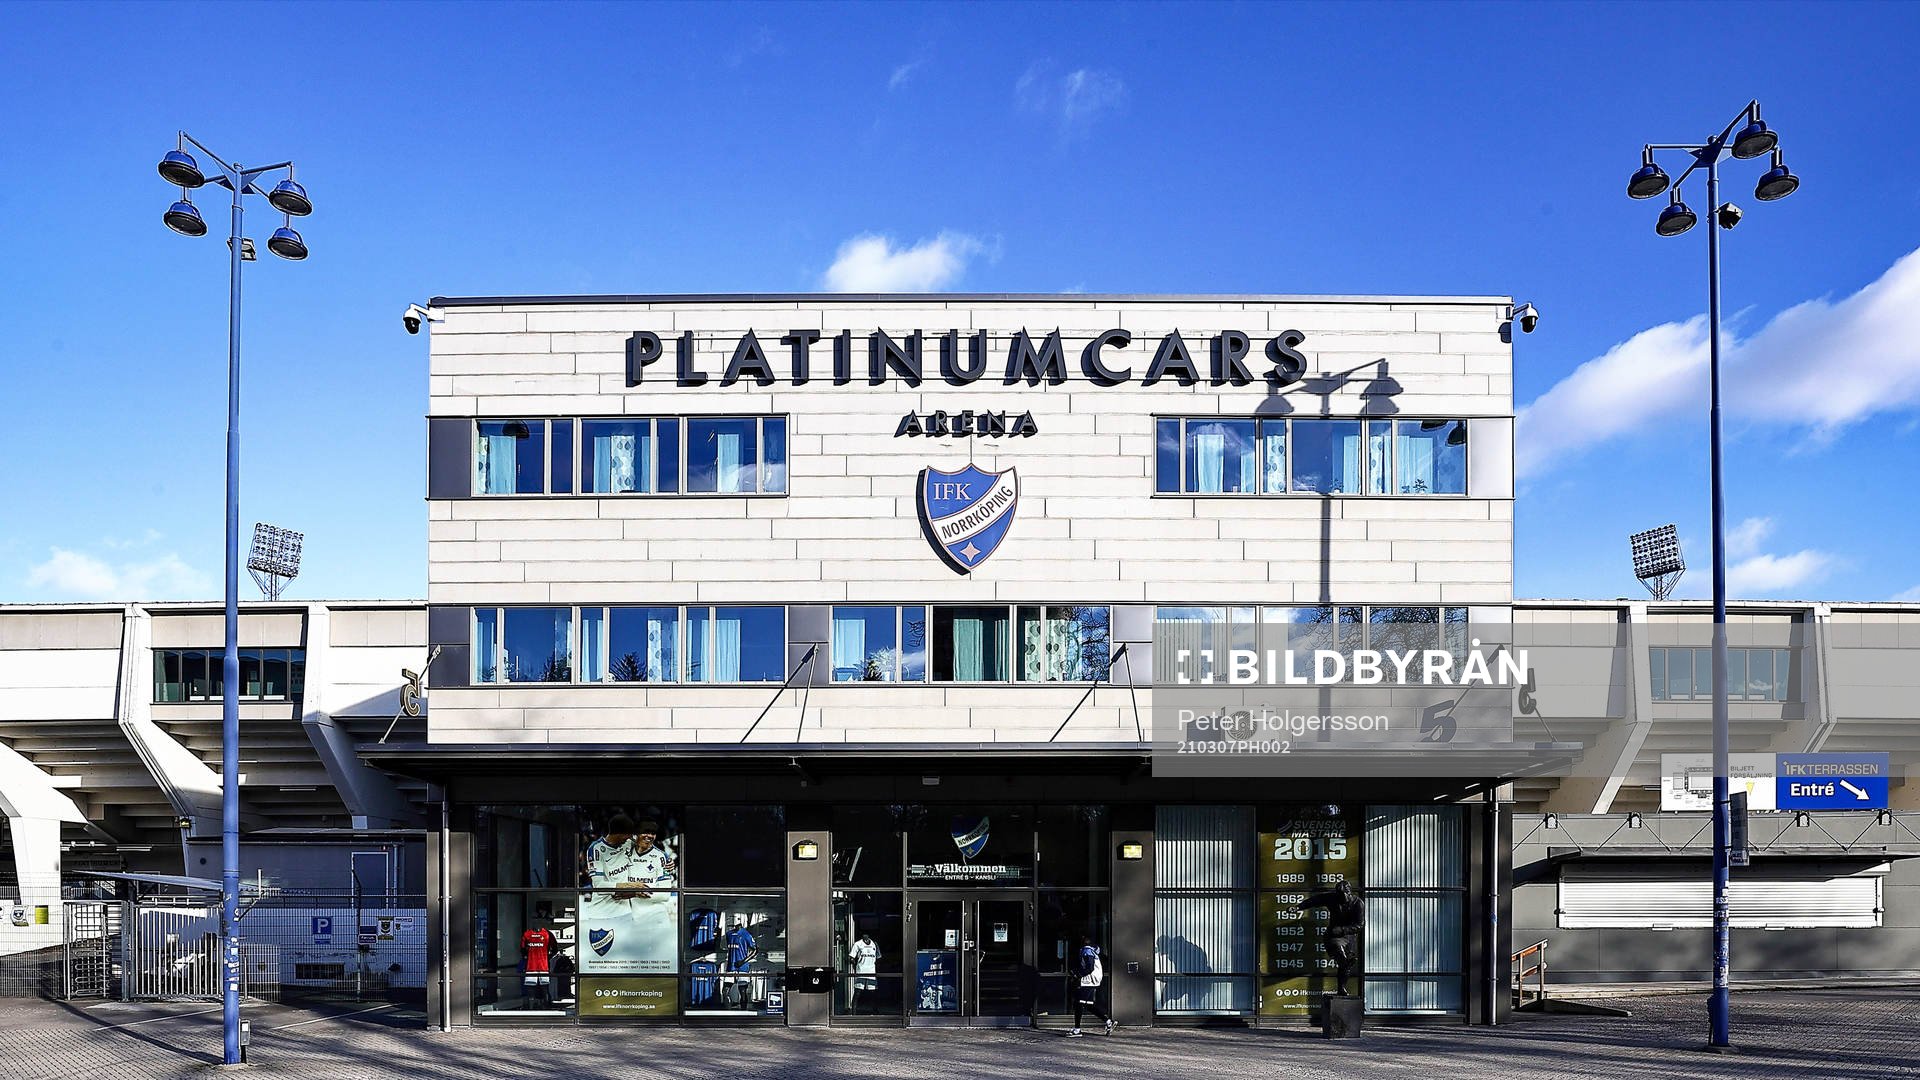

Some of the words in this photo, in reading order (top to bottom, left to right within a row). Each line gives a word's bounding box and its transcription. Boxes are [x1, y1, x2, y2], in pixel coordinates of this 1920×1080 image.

[629, 326, 1307, 384] PLATINUMCARS
[897, 410, 1038, 435] ARENA
[934, 483, 972, 500] IFK
[941, 485, 1013, 539] NORRKÖPING
[1785, 763, 1879, 775] IFKTERRASSEN
[1790, 782, 1835, 796] Entré
[1293, 820, 1346, 829] SVENSKA
[1274, 838, 1347, 860] 2015
[935, 863, 1006, 873] Välkommen
[1276, 874, 1305, 883] 1989
[1316, 874, 1344, 883] 1963
[1275, 895, 1304, 904] 1962
[1276, 910, 1304, 920] 1957
[317, 918, 329, 933] P
[1275, 927, 1304, 936] 1952
[1275, 943, 1304, 952] 1947
[1275, 959, 1304, 968] 1945
[1315, 959, 1339, 968] 194
[619, 990, 663, 998] ifknorrkoping
